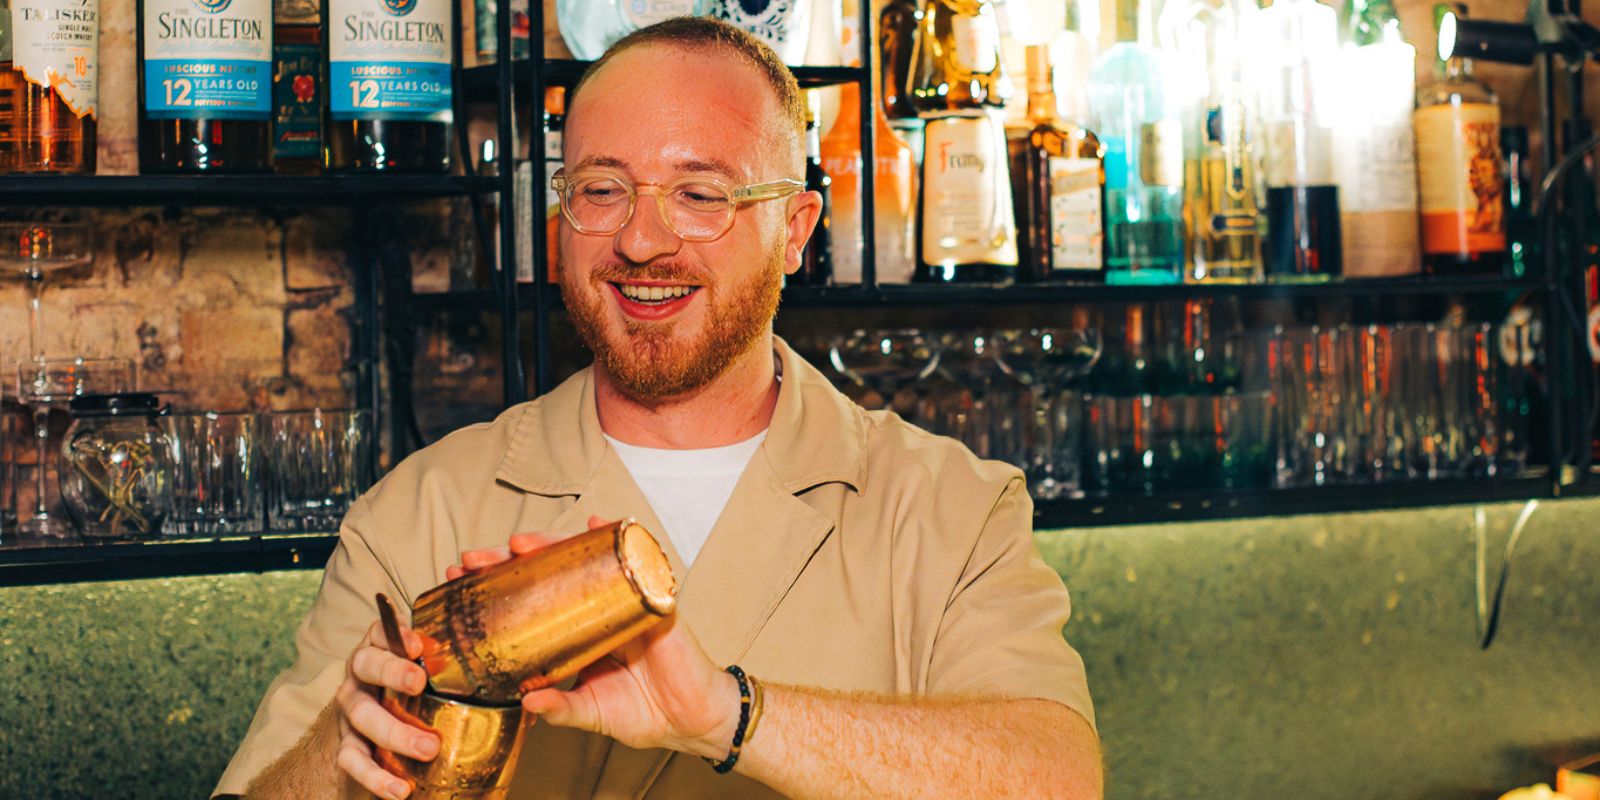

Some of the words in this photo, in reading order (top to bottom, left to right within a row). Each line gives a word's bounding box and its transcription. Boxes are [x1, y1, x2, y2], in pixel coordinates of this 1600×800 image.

[158, 12, 263, 39] SINGLETON
[343, 15, 444, 43] SINGLETON
[164, 63, 217, 73] LUSCIOUS
[162, 78, 192, 106] 12
[193, 79, 233, 90] YEARS
[236, 80, 258, 90] OLD
[349, 79, 380, 108] 12
[380, 81, 418, 92] YEARS
